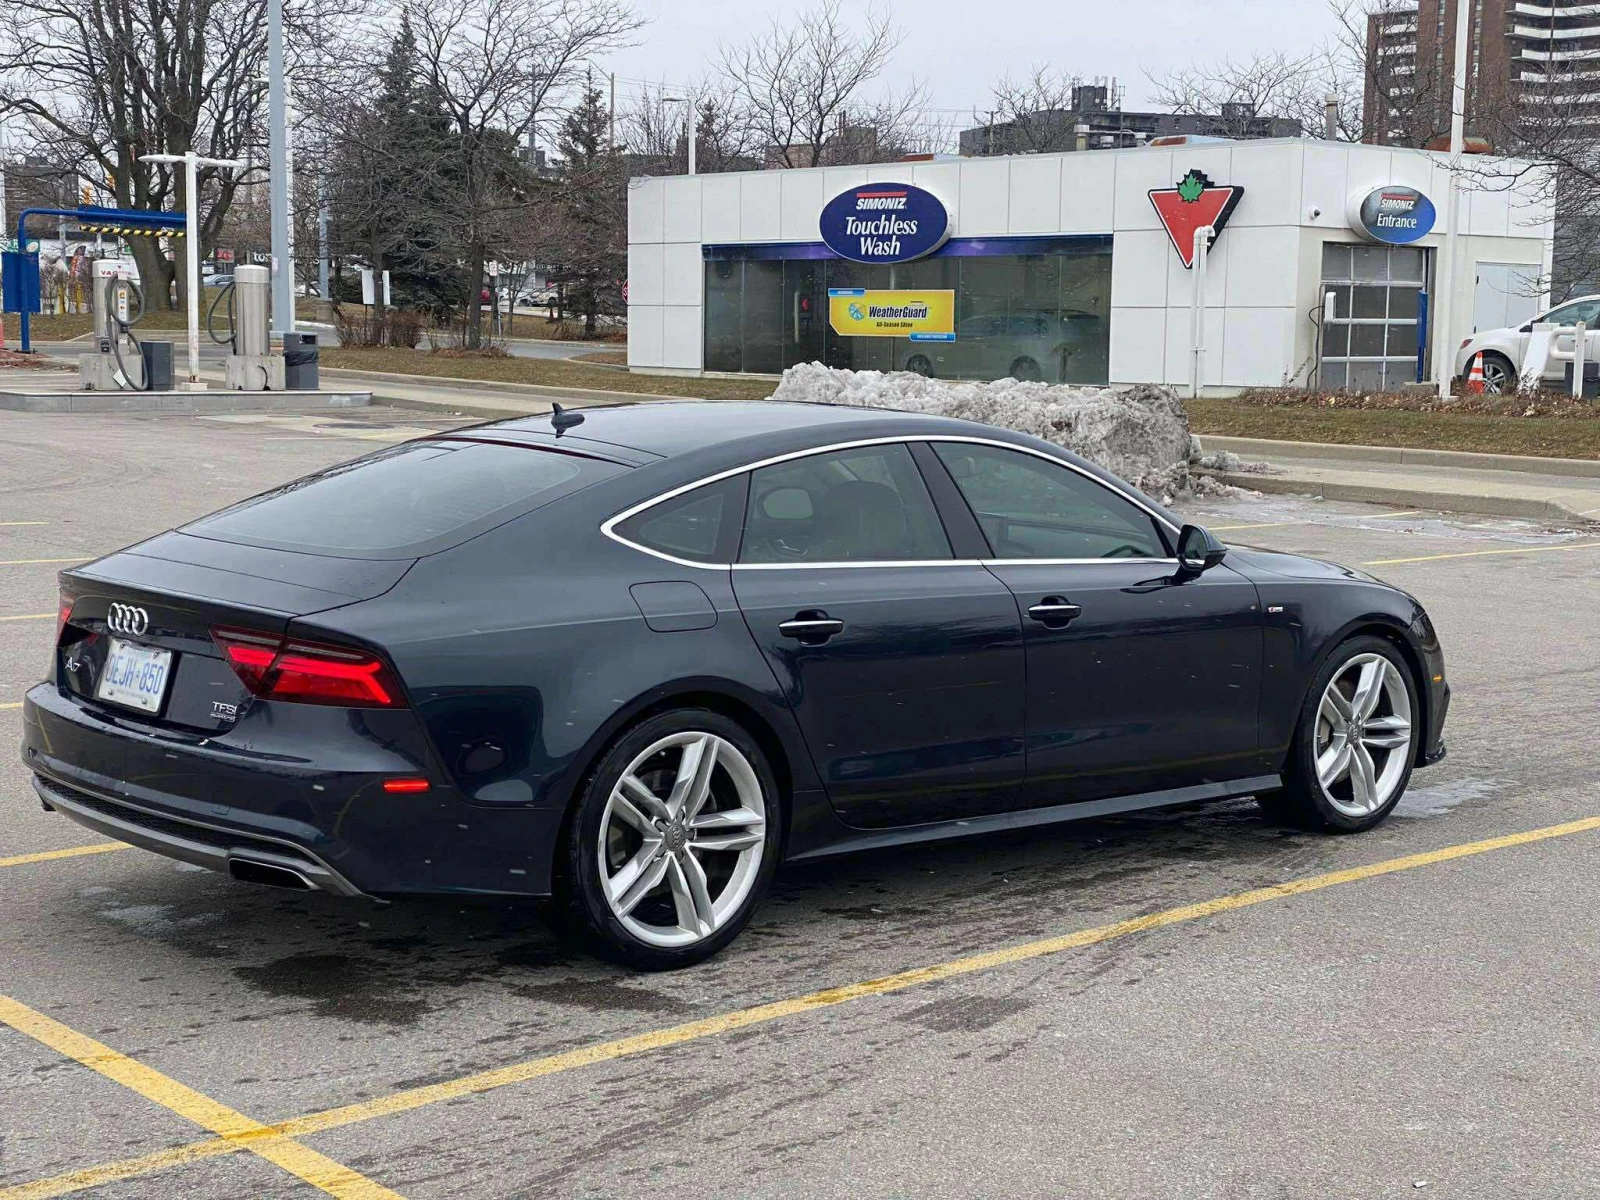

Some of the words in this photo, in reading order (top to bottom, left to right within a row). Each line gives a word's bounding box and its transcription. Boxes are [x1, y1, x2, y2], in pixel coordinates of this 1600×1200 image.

[856, 197, 907, 210] SIMONIZ
[1381, 198, 1415, 210] SIMONIZ
[845, 214, 918, 235] Touchless
[1377, 212, 1417, 229] Entrance
[860, 235, 901, 256] Wash
[869, 306, 927, 318] WeatherGuard
[64, 656, 81, 673] A7
[212, 701, 238, 715] TFSI
